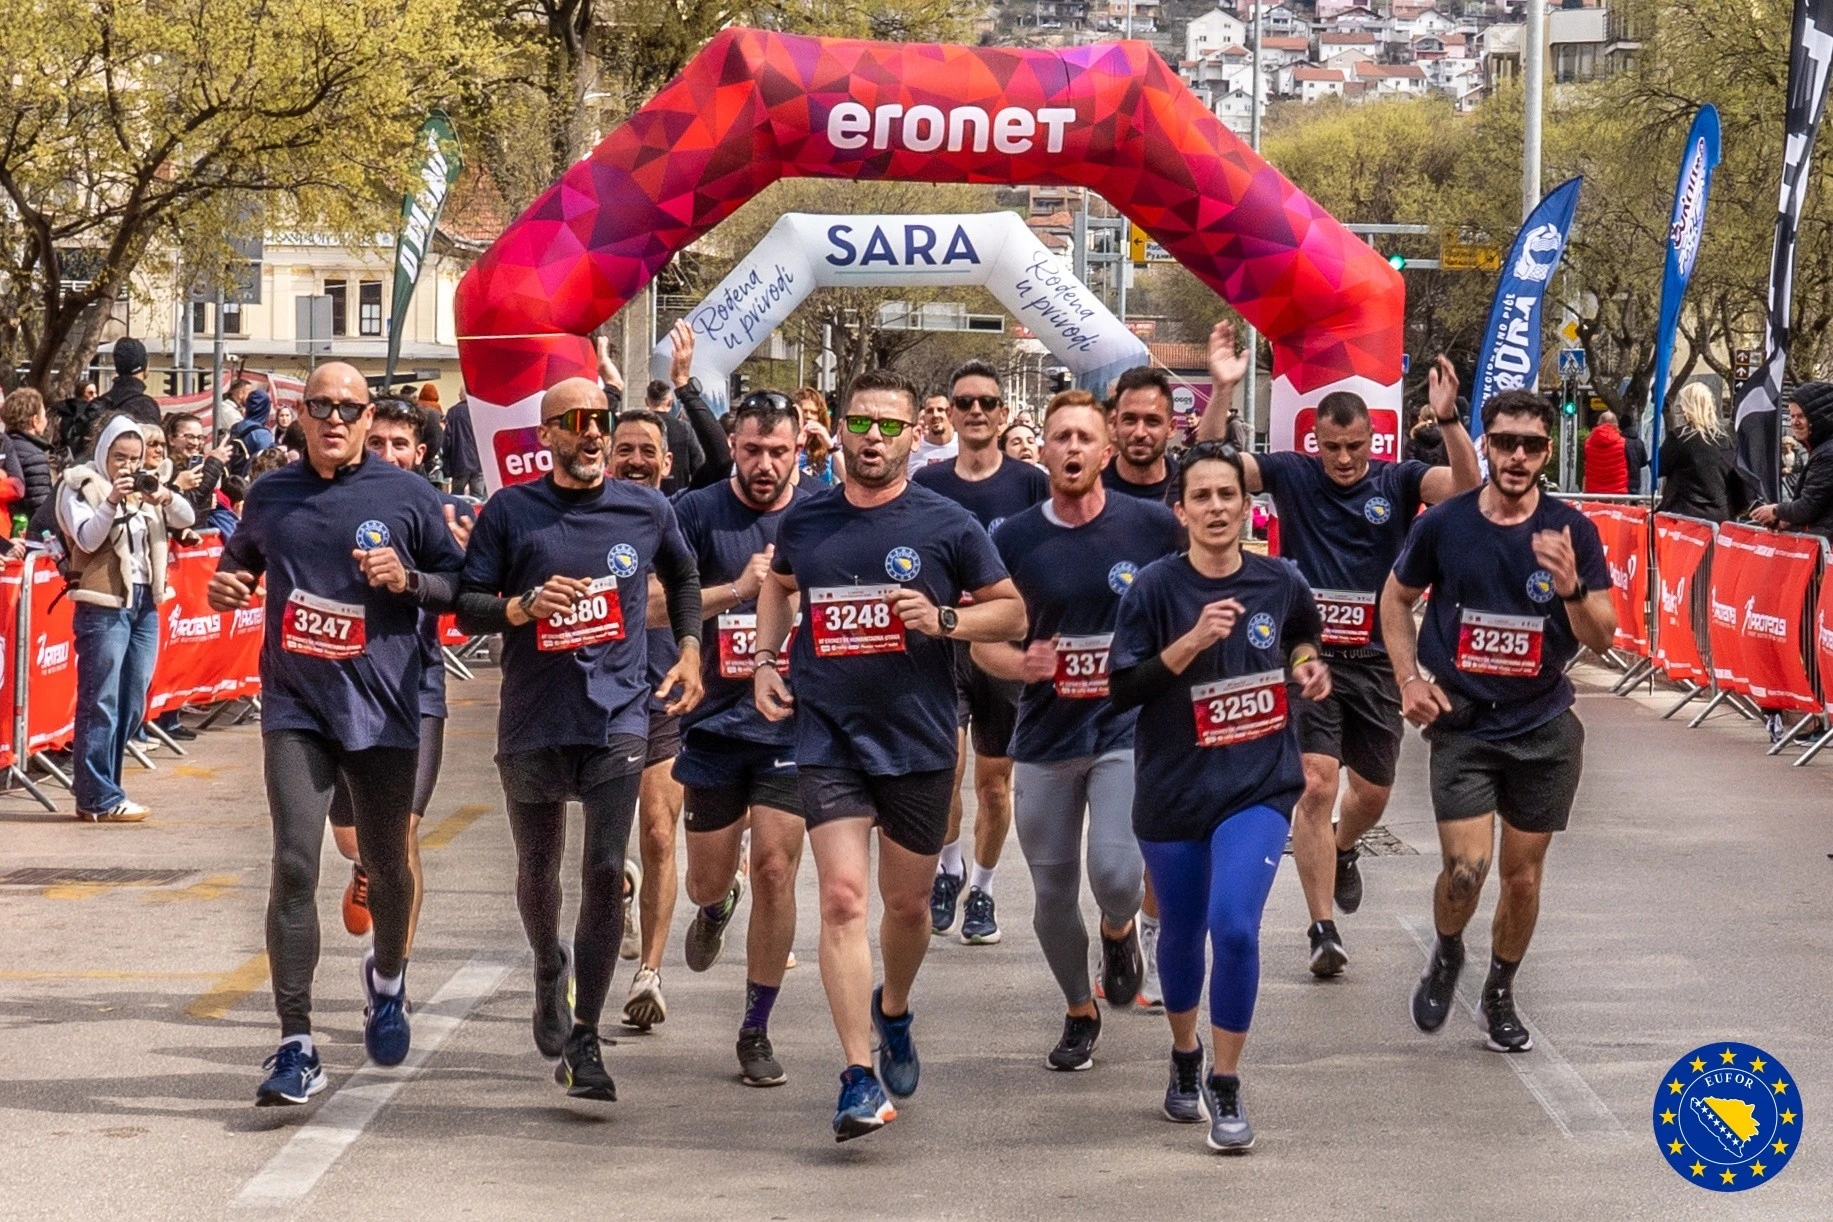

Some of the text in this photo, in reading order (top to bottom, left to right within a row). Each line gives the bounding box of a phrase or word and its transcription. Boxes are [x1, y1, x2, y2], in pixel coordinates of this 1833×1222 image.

[827, 102, 1076, 154] eronet
[825, 223, 981, 266] SARA
[1016, 279, 1033, 298] u
[723, 333, 743, 349] u
[1303, 432, 1395, 454] eet
[505, 450, 554, 475] ero
[294, 608, 352, 640] 3247
[825, 603, 890, 631] 3248
[1316, 603, 1365, 626] 3229
[1471, 628, 1530, 656] 3235
[1065, 651, 1110, 676] 337
[1208, 689, 1275, 724] 3250
